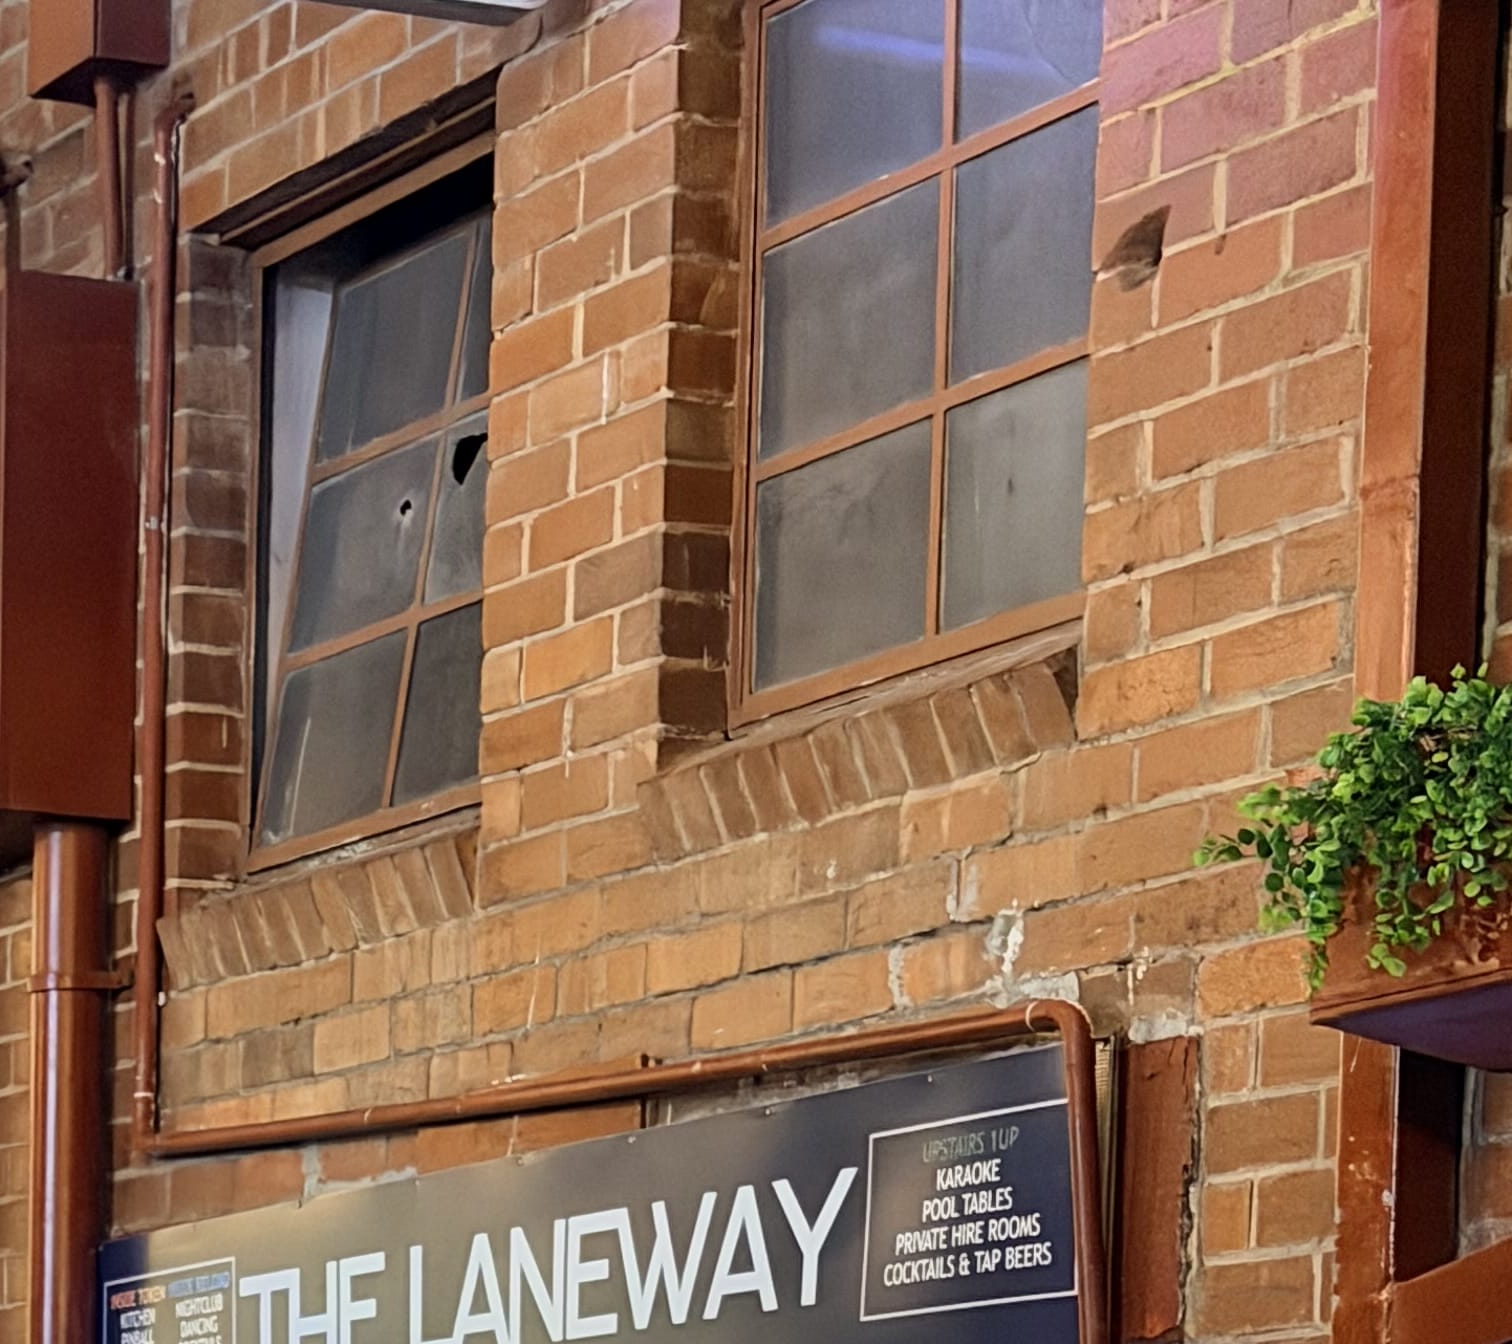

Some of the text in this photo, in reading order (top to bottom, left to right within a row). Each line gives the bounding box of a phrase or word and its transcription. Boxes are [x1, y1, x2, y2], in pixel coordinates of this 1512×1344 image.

[936, 1159, 1001, 1191] KARAOKE
[922, 1186, 1013, 1223] POOL TABLES
[895, 1213, 1041, 1256] PRIVATE HIRE ROOMS
[883, 1242, 1052, 1286] COCKTAILS & TAP BEERS
[120, 1308, 156, 1329] KITCHEN
[176, 1292, 223, 1318] NIGHTCLUB
[180, 1315, 218, 1338] DANCING
